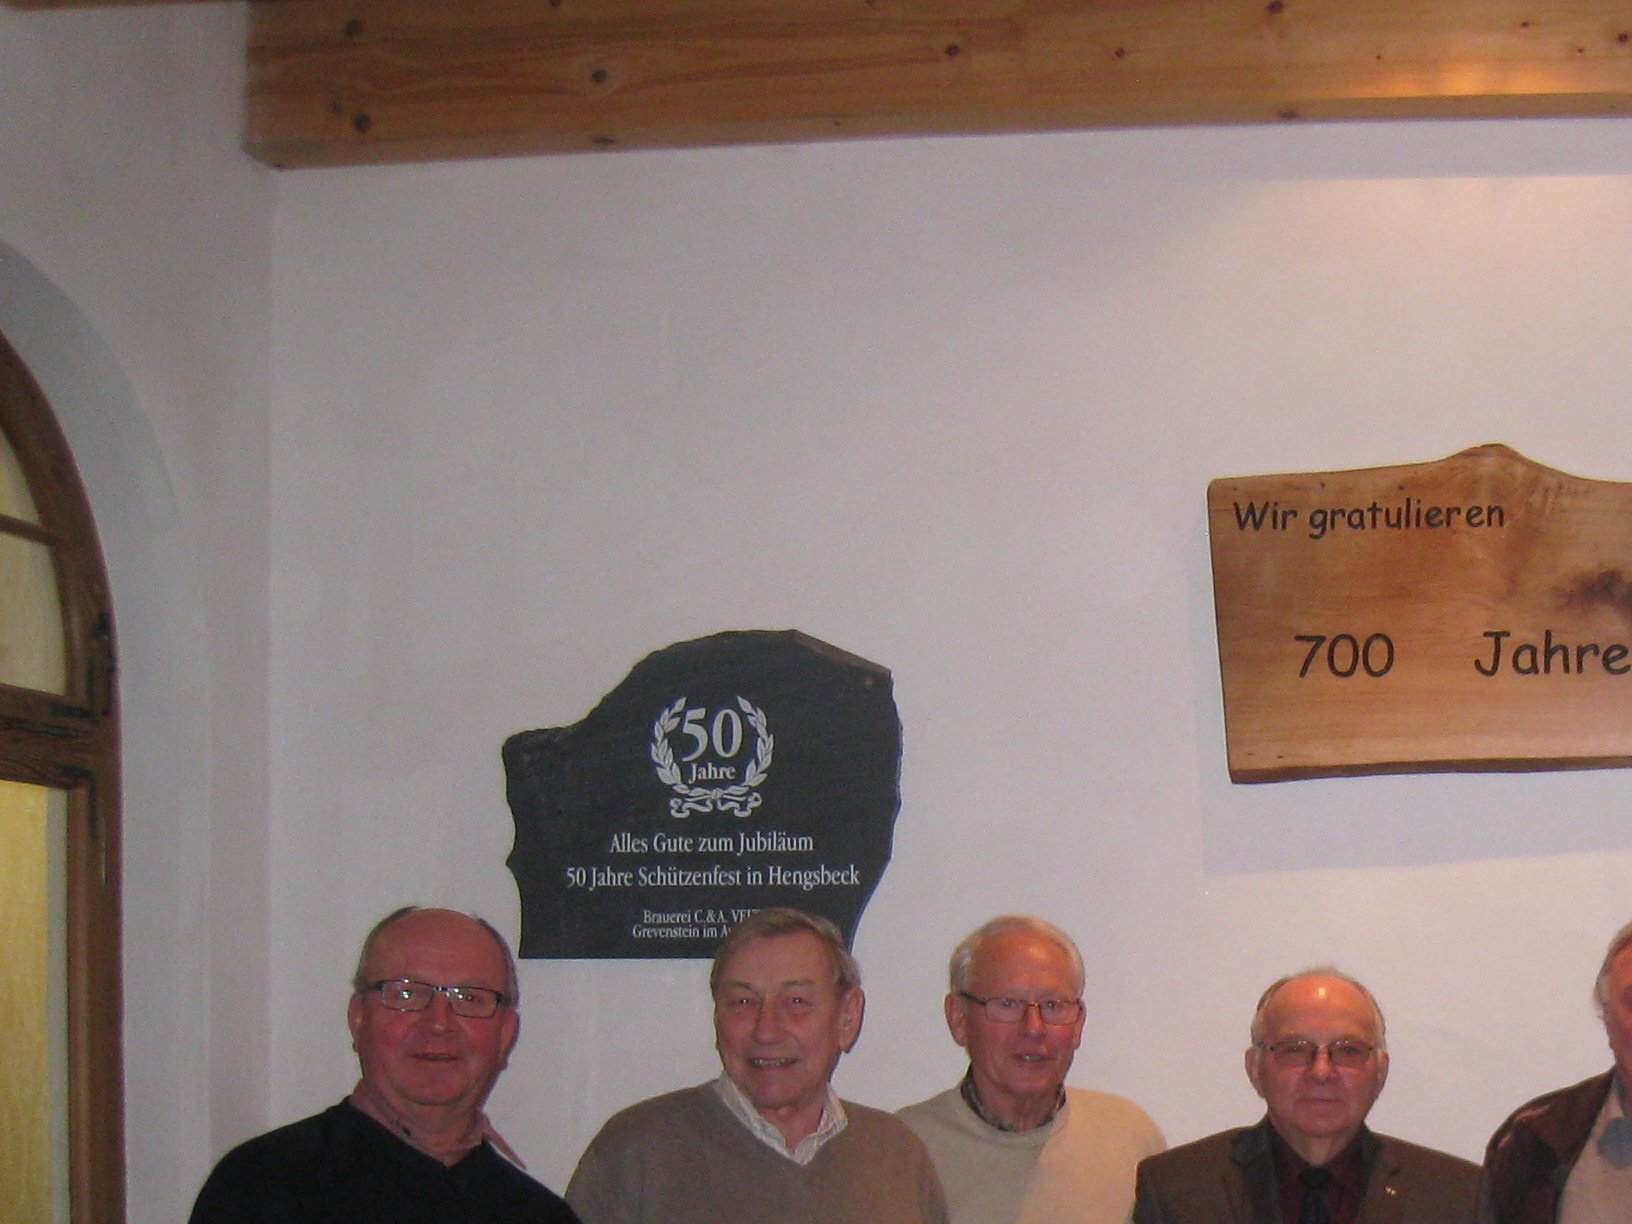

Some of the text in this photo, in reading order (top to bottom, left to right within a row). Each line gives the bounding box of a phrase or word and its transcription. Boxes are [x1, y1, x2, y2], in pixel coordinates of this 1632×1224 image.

[1232, 497, 1506, 540] Wir gratulieren
[1293, 631, 1396, 679] 700
[1473, 628, 1632, 678] Jahre
[681, 708, 744, 763] 50
[688, 762, 736, 785] Jahre
[609, 829, 815, 857] Alles Gute zum Jubiläum
[565, 862, 861, 892] 50 Jahre Schützenfest in Hengsbeck
[643, 908, 692, 924] Brauerei
[632, 924, 700, 938] Grevenstein
[703, 925, 718, 938] im
